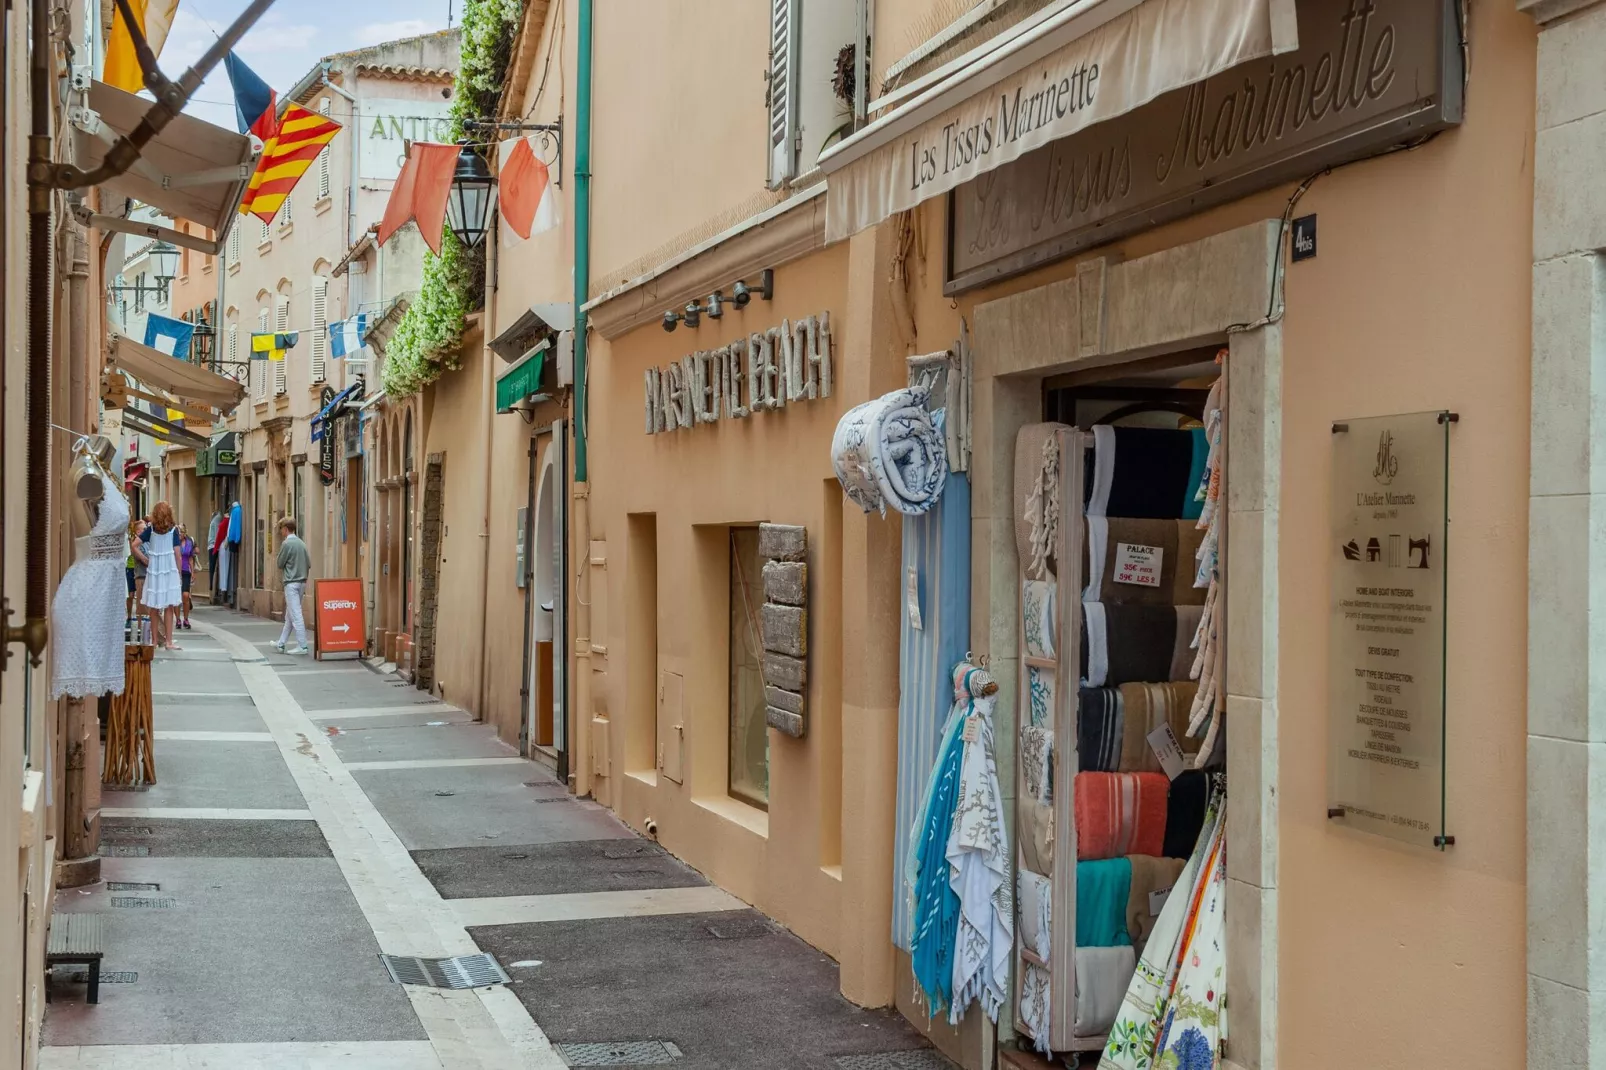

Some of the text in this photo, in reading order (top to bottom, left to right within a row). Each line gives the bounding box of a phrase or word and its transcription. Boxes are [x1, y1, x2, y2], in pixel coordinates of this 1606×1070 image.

[911, 61, 1099, 190] Les Tissus Marinette
[323, 389, 332, 470] ANQUITES
[1356, 492, 1415, 506] L'Atelier Marinette
[1126, 545, 1154, 555] PALACE
[1356, 587, 1368, 595] HOME
[1368, 587, 1378, 596] AND
[1378, 588, 1390, 596] BOAT
[1368, 646, 1400, 657] DEVIS GRATUIT
[1355, 668, 1366, 677] TOUT
[1366, 670, 1377, 679] TYPE
[1378, 671, 1384, 680] DE
